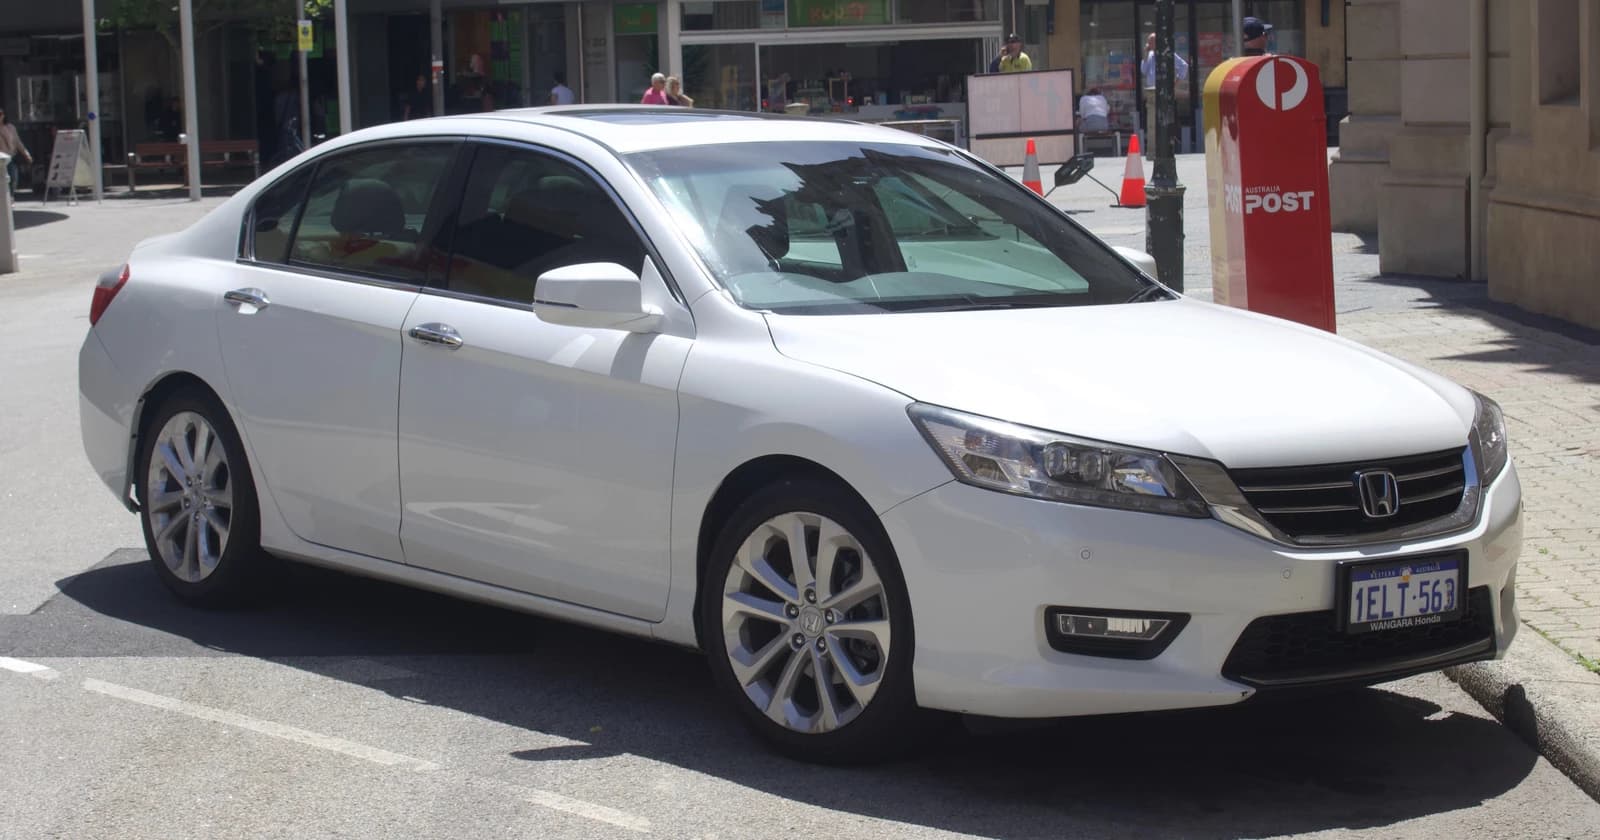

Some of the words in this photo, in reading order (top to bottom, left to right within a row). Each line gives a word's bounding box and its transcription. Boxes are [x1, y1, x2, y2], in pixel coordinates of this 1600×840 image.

[1245, 185, 1280, 194] AUSTRALIA
[1245, 191, 1315, 214] POST
[1370, 619, 1413, 632] WANGARA
[1415, 614, 1441, 625] Honda
